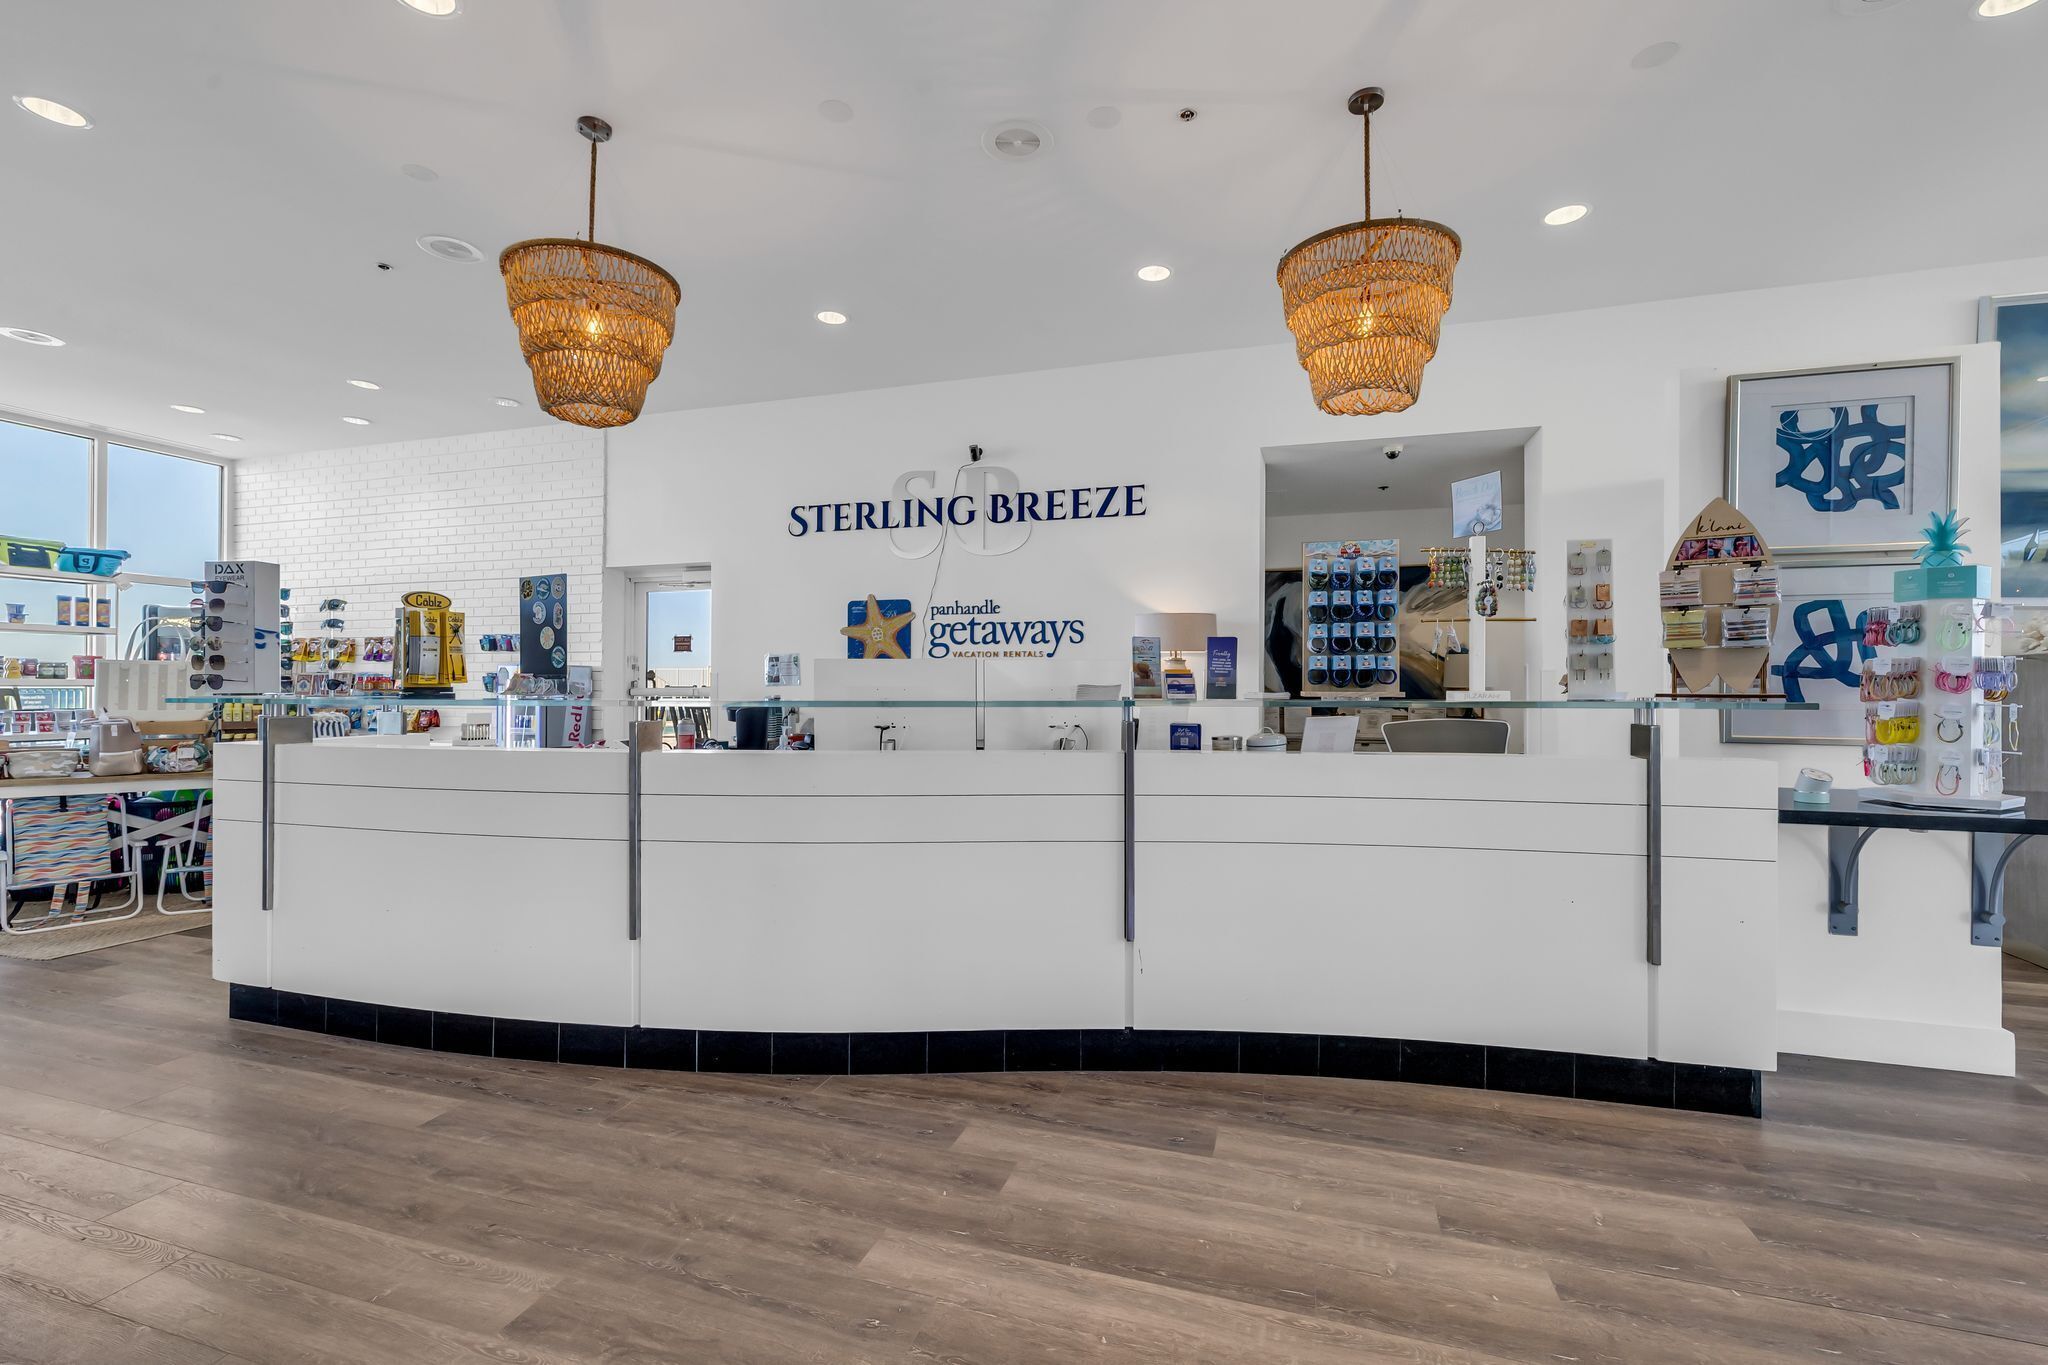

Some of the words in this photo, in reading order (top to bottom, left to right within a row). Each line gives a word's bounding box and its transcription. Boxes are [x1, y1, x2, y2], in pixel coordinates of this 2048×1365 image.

[788, 495, 976, 537] STERLING
[986, 484, 1147, 524] BREEZE
[214, 563, 245, 575] DAX
[930, 599, 1001, 620] panhandle
[928, 616, 1085, 659] getaways
[952, 650, 999, 658] VACATION
[1003, 650, 1044, 658] RENTALS
[568, 712, 583, 742] Red
